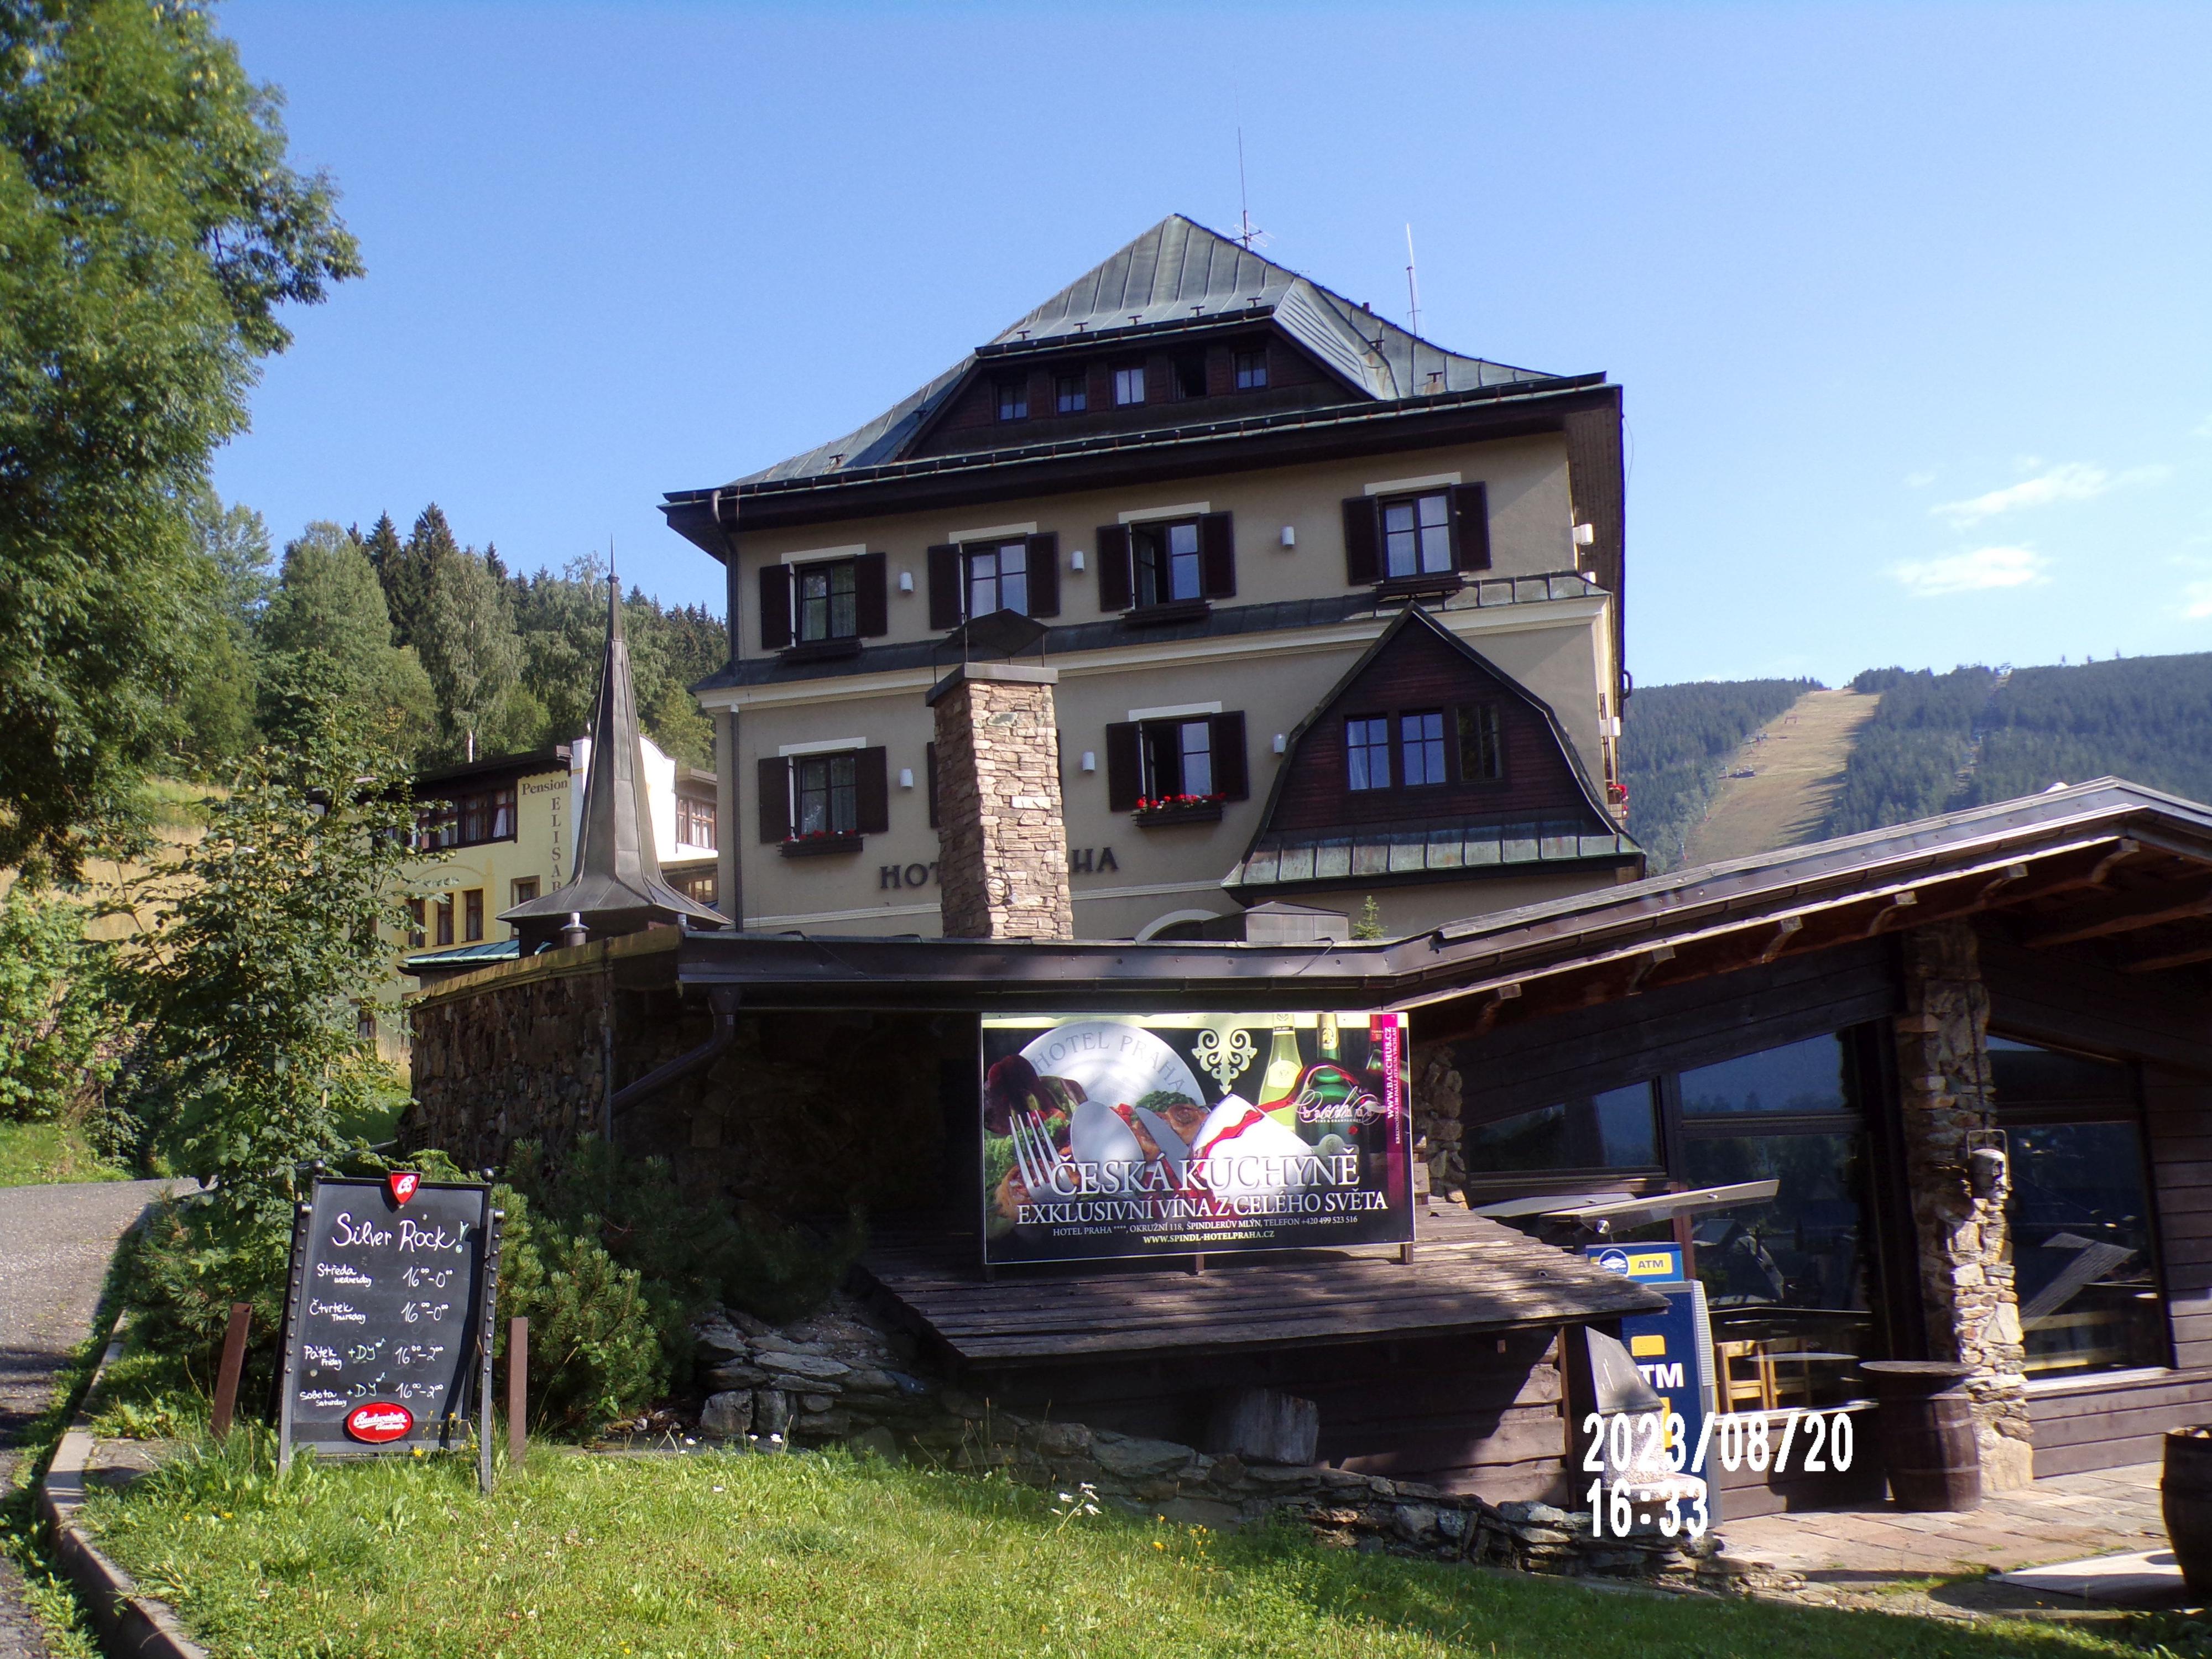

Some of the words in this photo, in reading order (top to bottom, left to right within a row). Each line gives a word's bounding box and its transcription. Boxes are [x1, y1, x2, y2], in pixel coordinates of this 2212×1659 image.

[521, 779, 568, 796] Pension
[551, 796, 561, 891] ELISAB
[1031, 1031, 1110, 1074] HOTEL
[1120, 1035, 1185, 1091] PRAHA
[1385, 1027, 1394, 1119] WWW.BACCHUS.CZ
[1051, 1152, 1174, 1196] ČESKÁ
[1179, 1147, 1360, 1191] KUCHYNĚ
[1016, 1196, 1154, 1225] EXKLUSIVNÍ
[1155, 1194, 1214, 1218] VÍNA
[1215, 1196, 1234, 1217] Z
[1234, 1191, 1321, 1215] CELÉHO
[1325, 1188, 1389, 1212] SVĚTA
[332, 1212, 392, 1247] Silver
[1053, 1227, 1083, 1237] HOTEL
[1084, 1225, 1112, 1235] PRAHA
[1129, 1222, 1168, 1233] OKRUŽNÍ
[1169, 1223, 1185, 1232] 118,
[1186, 1220, 1238, 1231] ŠPINDLERŮV
[1238, 1218, 1263, 1229] MLÝN,
[1264, 1218, 1300, 1227] TELEFON
[1301, 1217, 1318, 1225] +420
[1318, 1216, 1332, 1224] 499
[1142, 1230, 1275, 1244] WWW.SPINDL-HOTELPRAHA.CZ
[317, 1262, 357, 1277] Středa
[1637, 1260, 1664, 1269] ATM
[309, 1298, 353, 1316] Čtvrtek
[332, 1313, 366, 1324] Thursday
[304, 1345, 337, 1360] Pátek
[321, 1358, 342, 1371] Friday
[1637, 1362, 1684, 1389] TM
